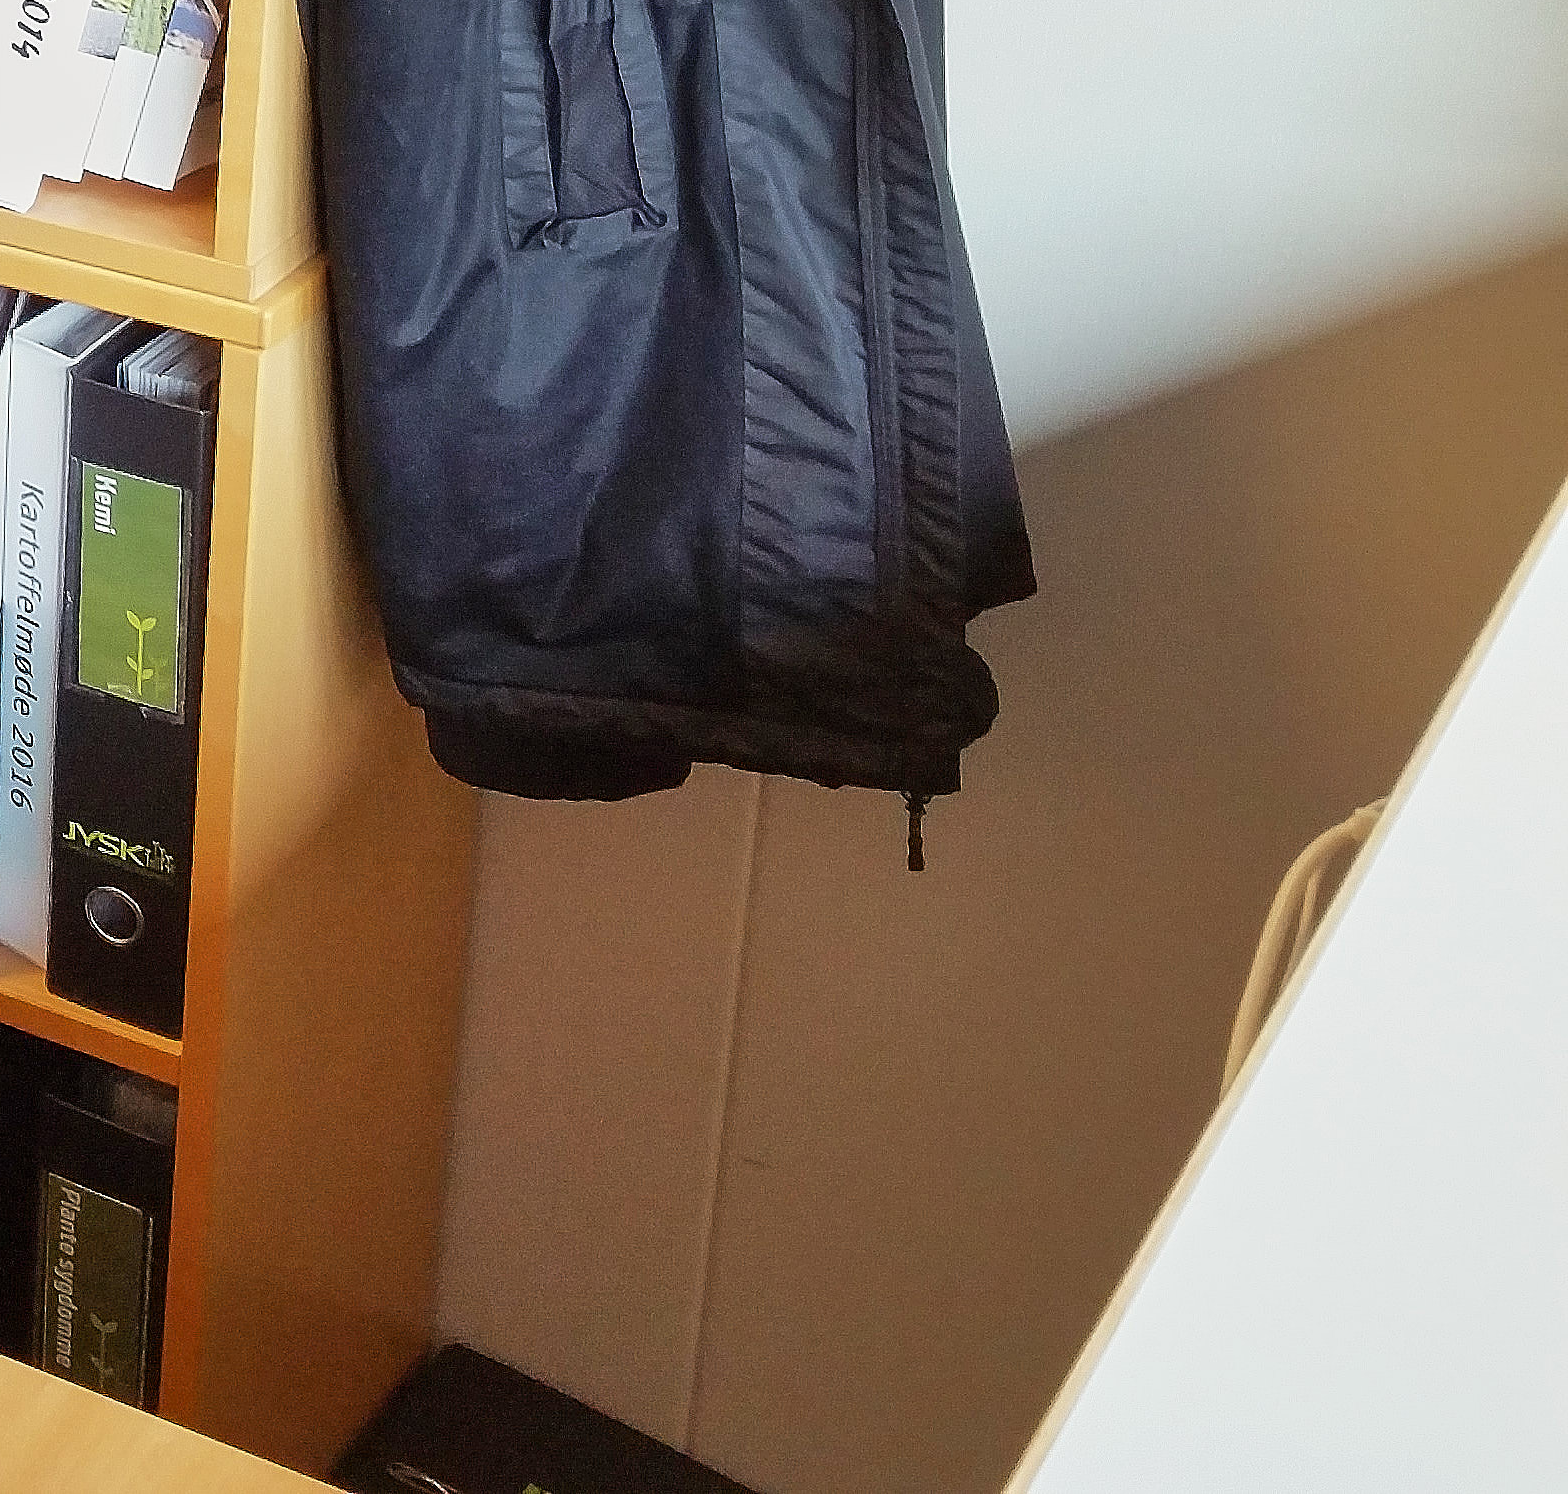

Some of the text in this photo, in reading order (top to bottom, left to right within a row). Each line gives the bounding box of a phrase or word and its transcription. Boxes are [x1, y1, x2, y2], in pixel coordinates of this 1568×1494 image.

[94, 474, 117, 536] Kemi
[9, 481, 44, 811] Kartoffelmøde 2016
[62, 821, 145, 866] JYSK
[54, 1186, 81, 1368] Plante sygdomme
